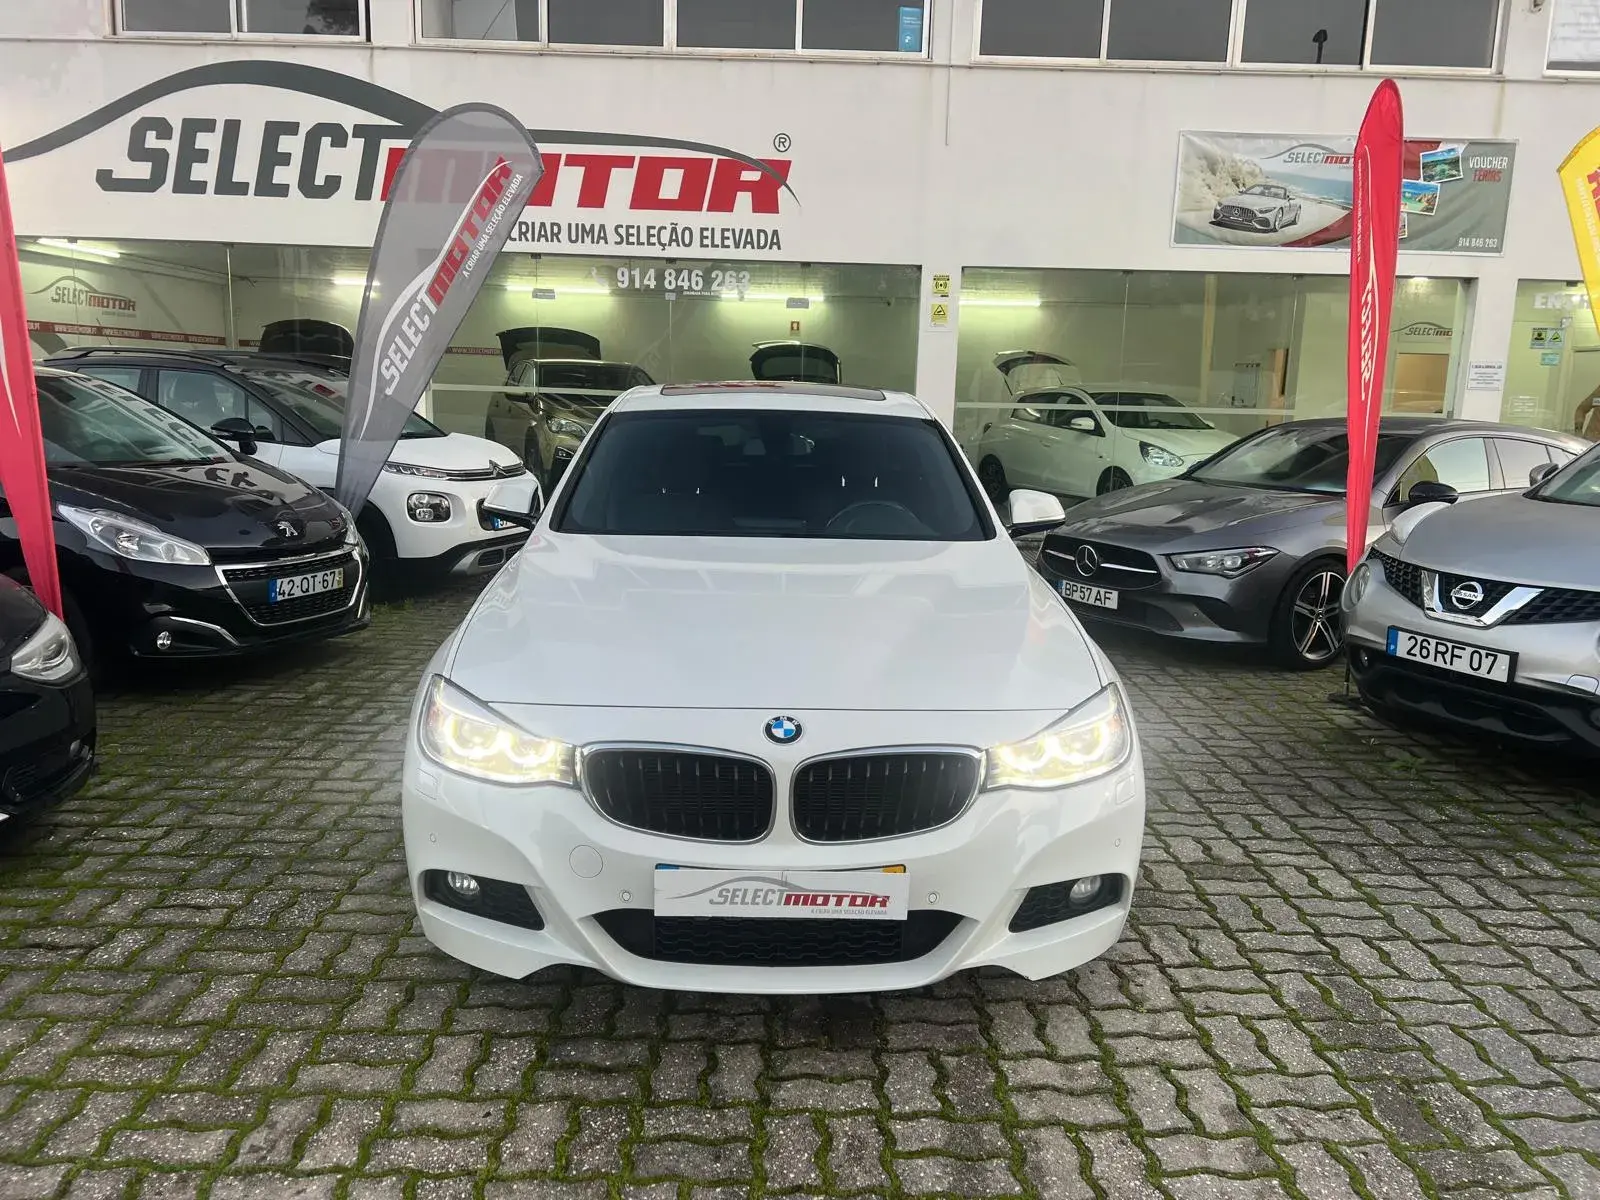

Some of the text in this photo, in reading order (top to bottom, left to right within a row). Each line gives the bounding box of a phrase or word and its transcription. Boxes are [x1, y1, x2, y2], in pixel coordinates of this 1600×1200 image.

[1283, 151, 1355, 165] SELECTMO
[1469, 156, 1508, 169] VOUCHER
[462, 173, 524, 278] A CRIAR UMA SELEÇÃO ELEVADA
[567, 222, 609, 245] UMA
[613, 222, 694, 251] SELEÇÃO
[699, 226, 782, 251] ELEVADA
[380, 156, 514, 396] SELECTMOTOR
[616, 267, 751, 293] 914 846 263
[51, 286, 137, 312] SELECTMOTOR
[1452, 589, 1480, 600] NISSAN
[709, 888, 891, 909] SELECTMOTOR
